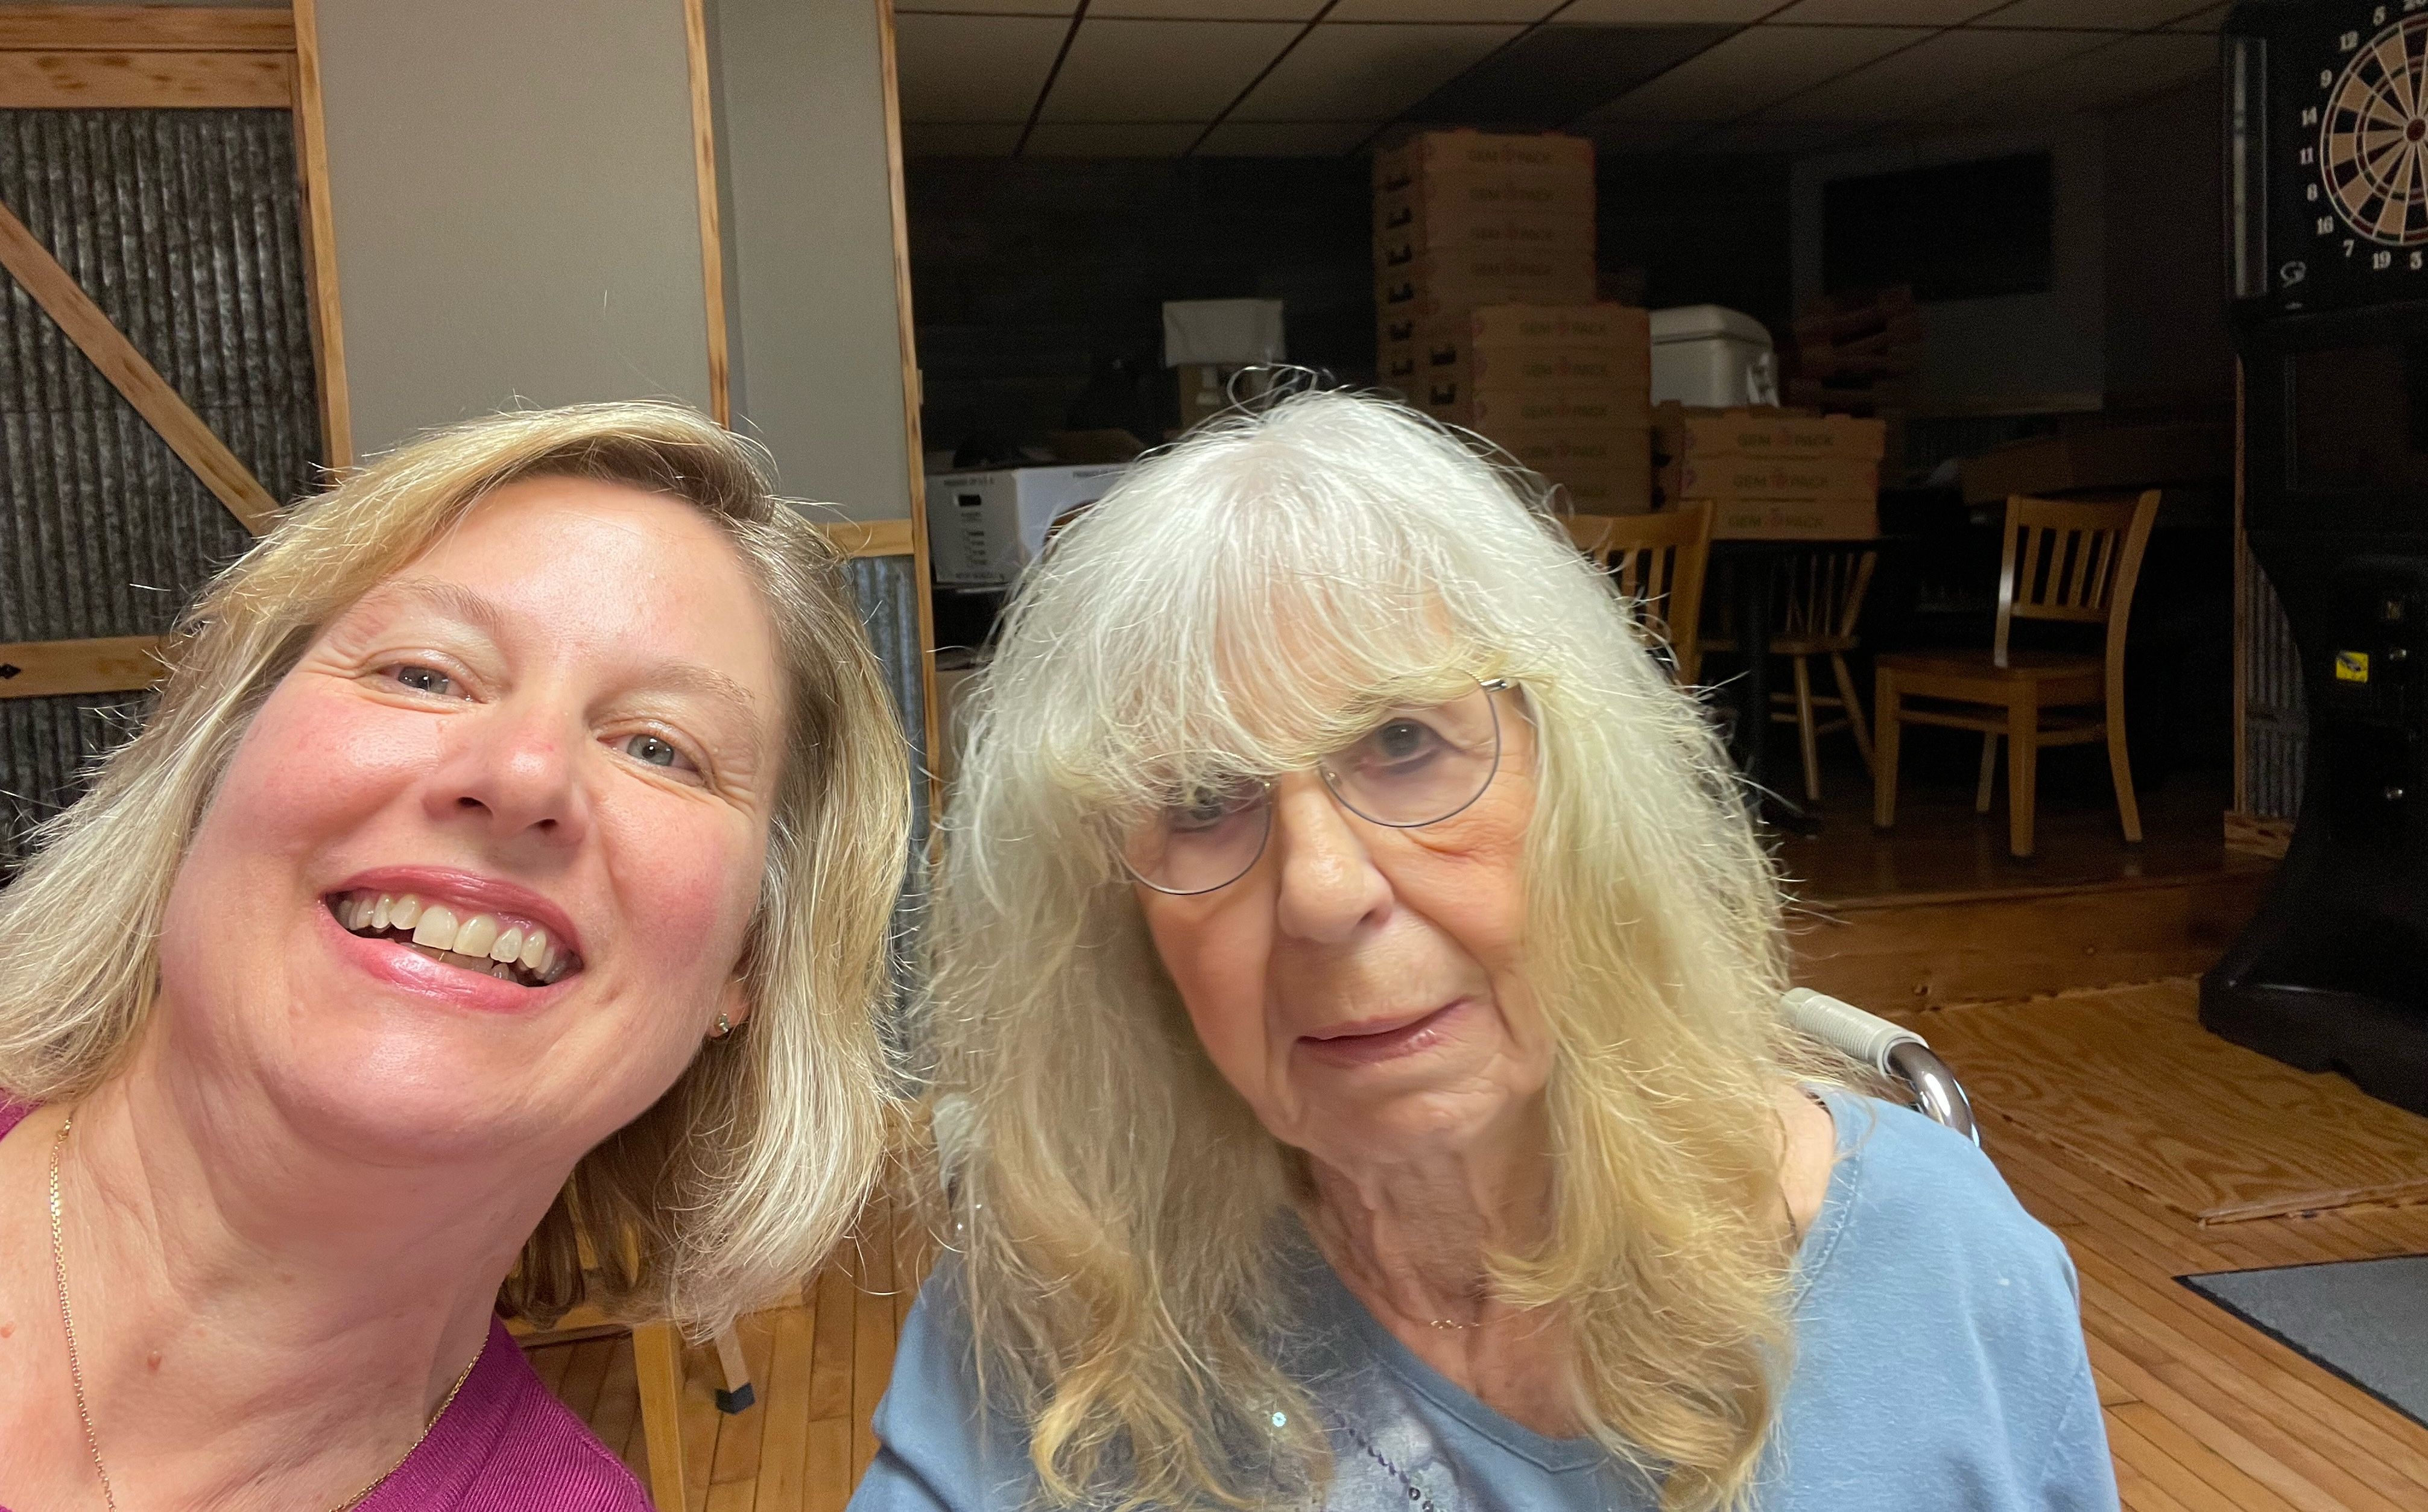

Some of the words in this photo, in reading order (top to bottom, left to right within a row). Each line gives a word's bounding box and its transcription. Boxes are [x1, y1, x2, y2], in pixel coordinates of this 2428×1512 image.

[2341, 31, 2358, 51] 12
[2321, 69, 2332, 87] 9
[2302, 107, 2317, 126] 14
[2301, 147, 2313, 165] 11
[2307, 184, 2318, 200] 8
[2317, 217, 2333, 235] 16
[2344, 240, 2354, 257] 7
[2373, 251, 2391, 269] 19
[1737, 434, 1771, 447] GEM
[1794, 434, 1833, 447] PACK
[1733, 475, 1766, 488] GEM
[1790, 476, 1829, 488] PACK
[1728, 515, 1762, 528] GEM
[1786, 516, 1824, 528] PACK
